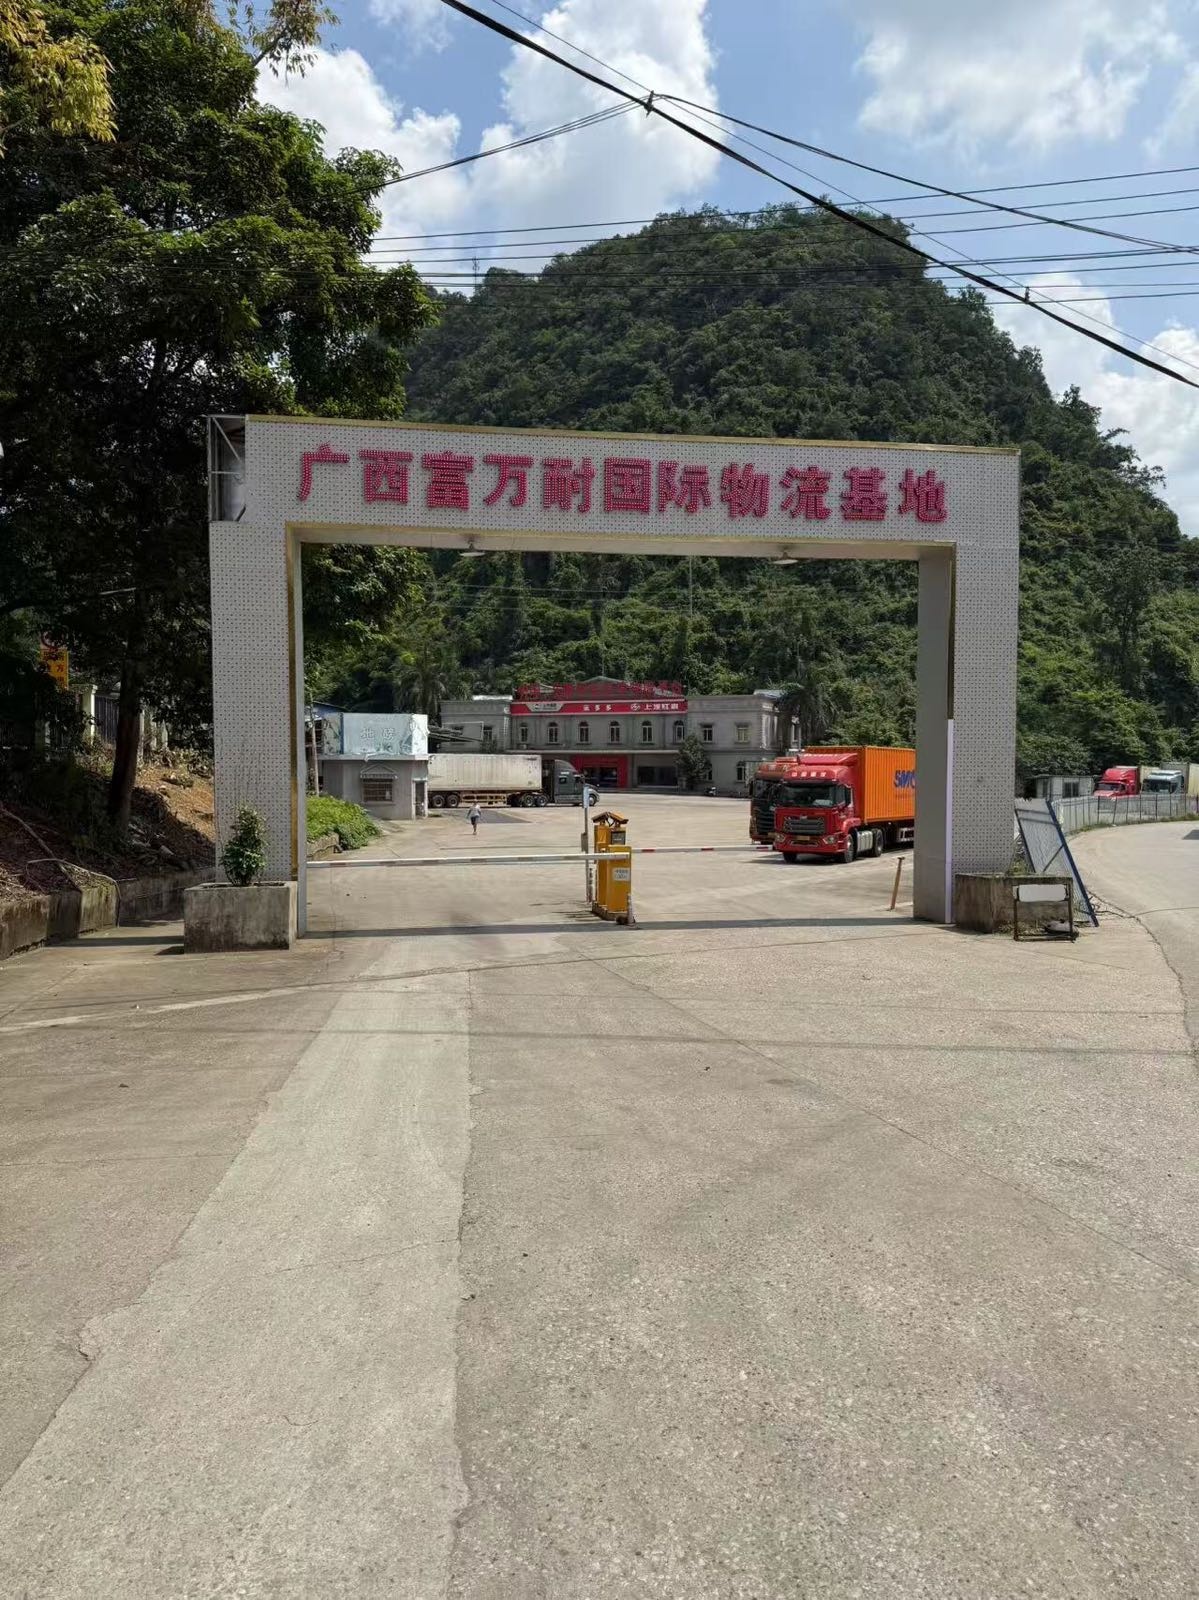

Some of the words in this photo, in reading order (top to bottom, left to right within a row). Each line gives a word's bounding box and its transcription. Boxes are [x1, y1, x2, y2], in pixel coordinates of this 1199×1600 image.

[298, 444, 948, 523] 广西富万耐国际物流基地
